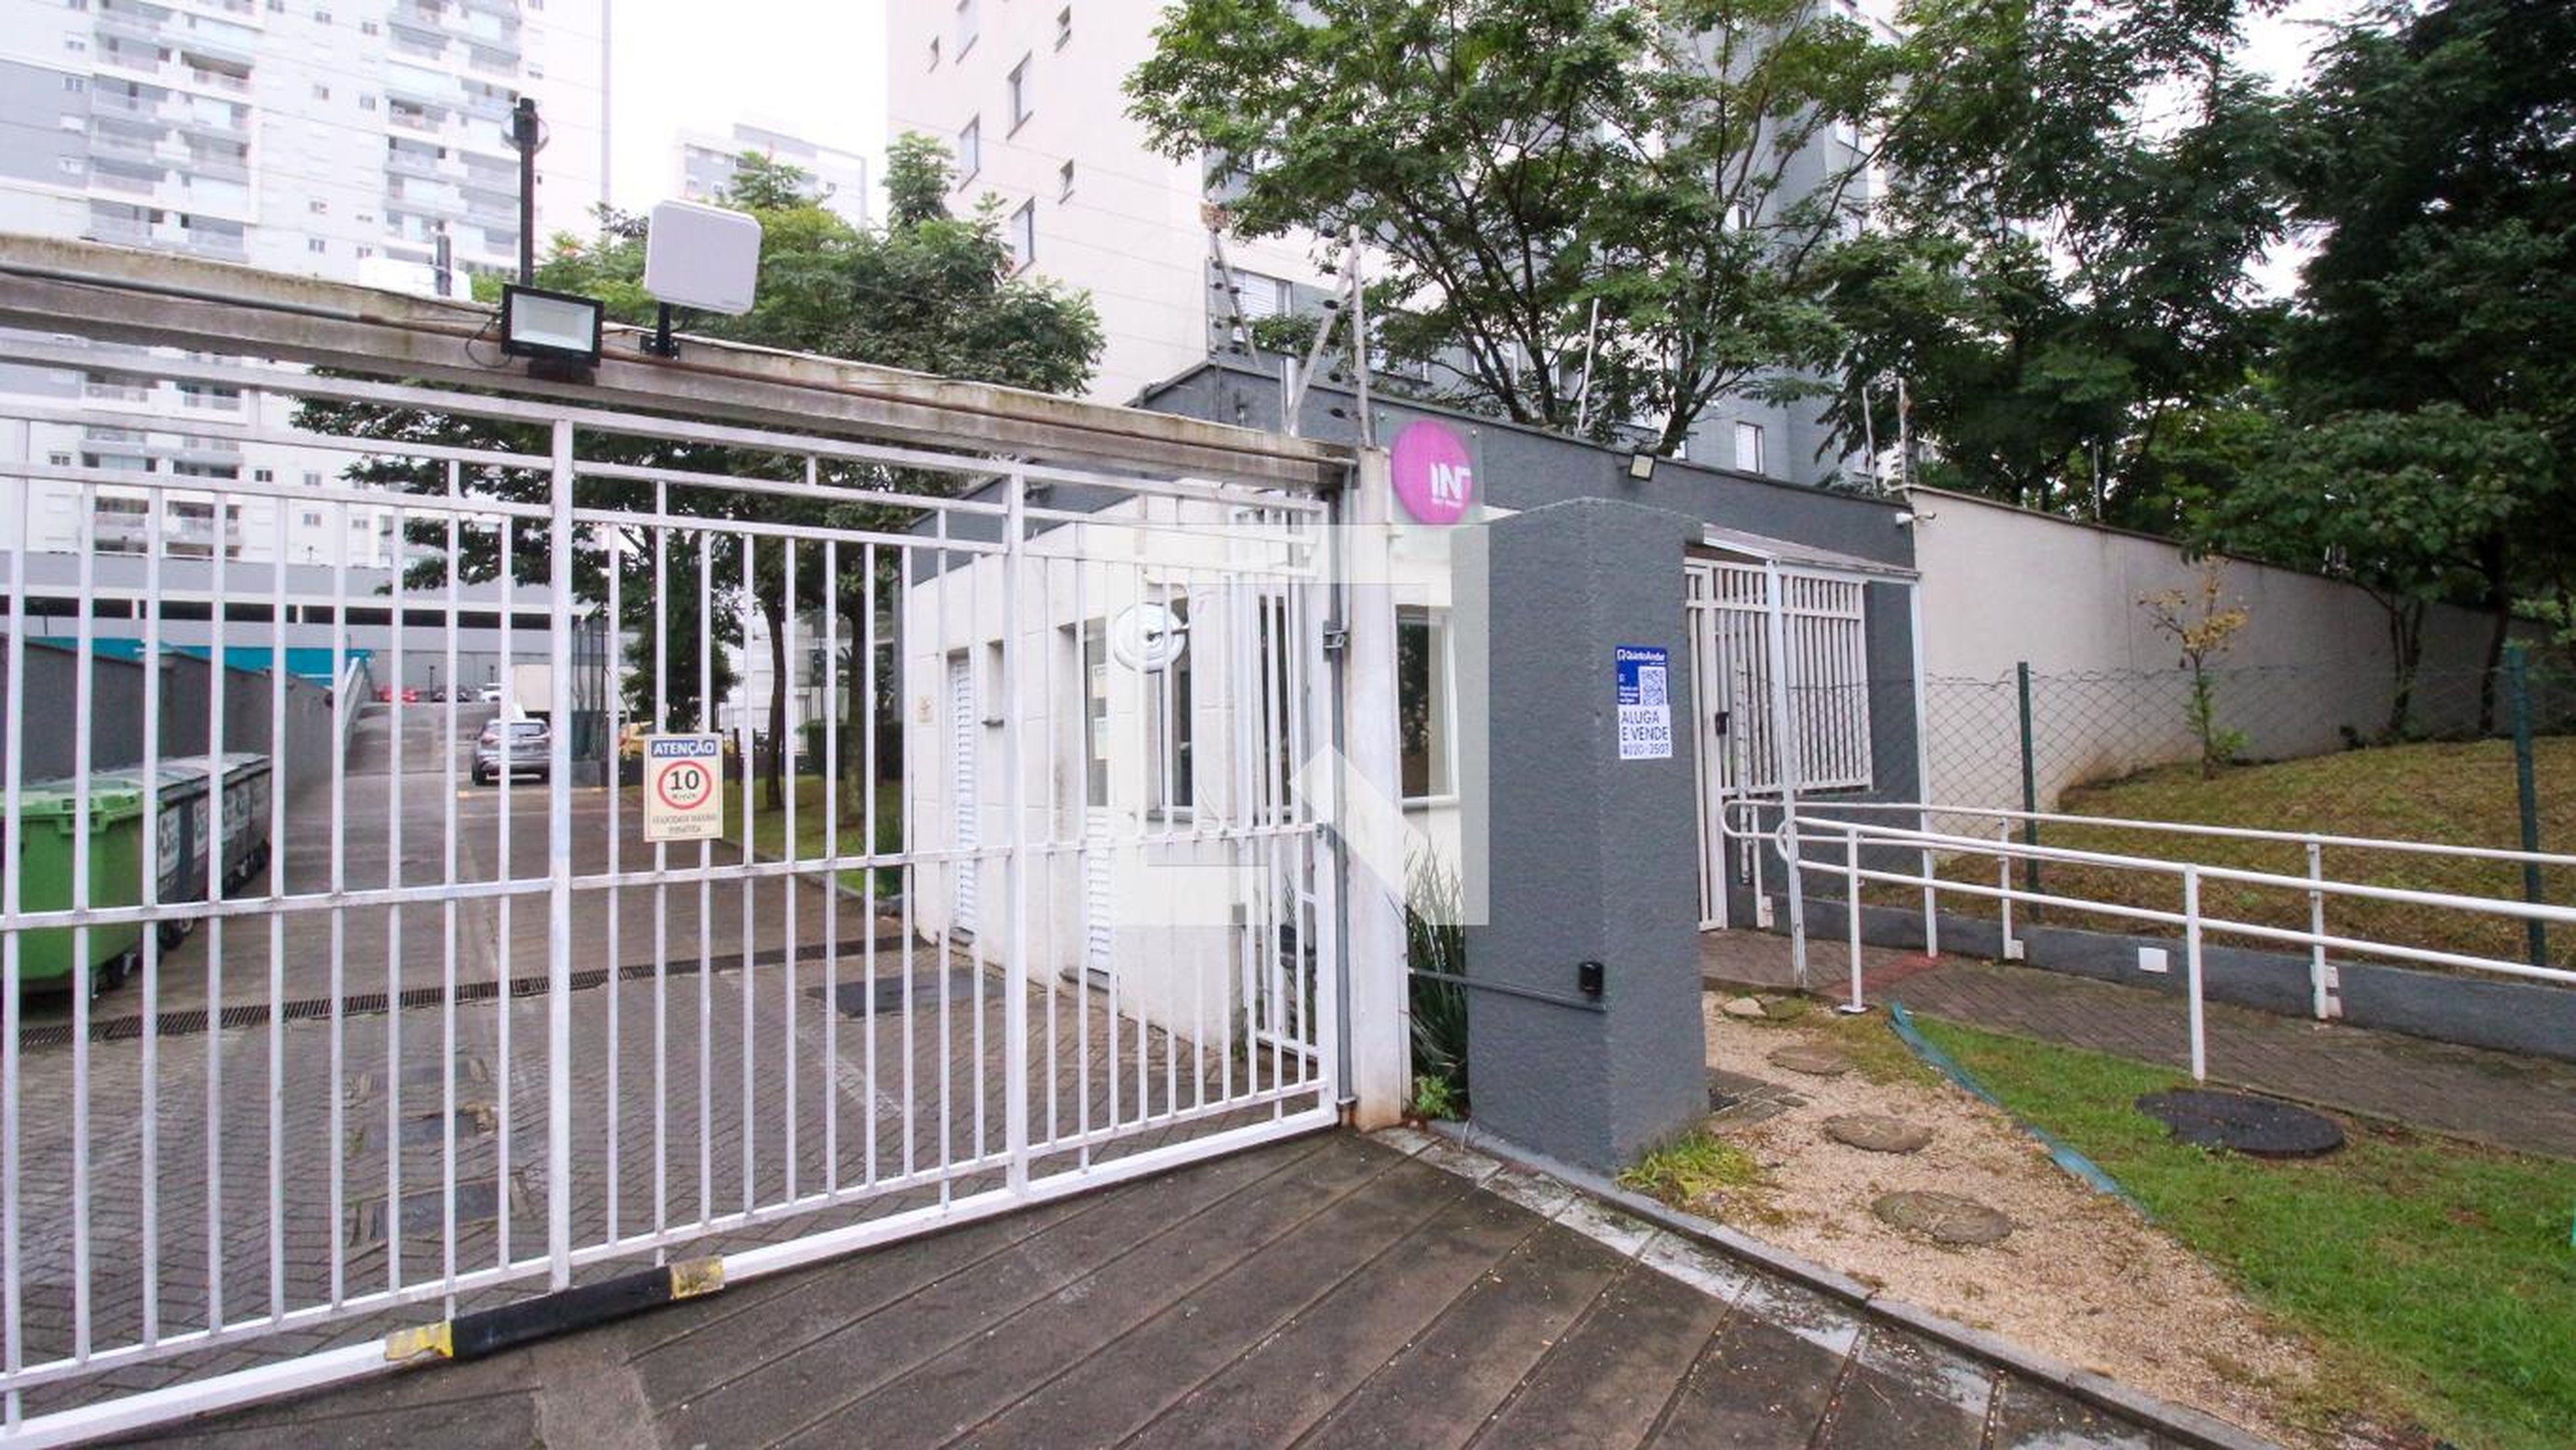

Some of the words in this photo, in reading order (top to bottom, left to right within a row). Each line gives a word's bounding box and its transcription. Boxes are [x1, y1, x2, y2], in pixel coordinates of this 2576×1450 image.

[1621, 710, 1660, 725] ALUGA
[1623, 726, 1628, 741] E
[1630, 726, 1669, 741] VENDE
[653, 741, 715, 755] ATENÇÃO
[669, 770, 700, 790] 10
